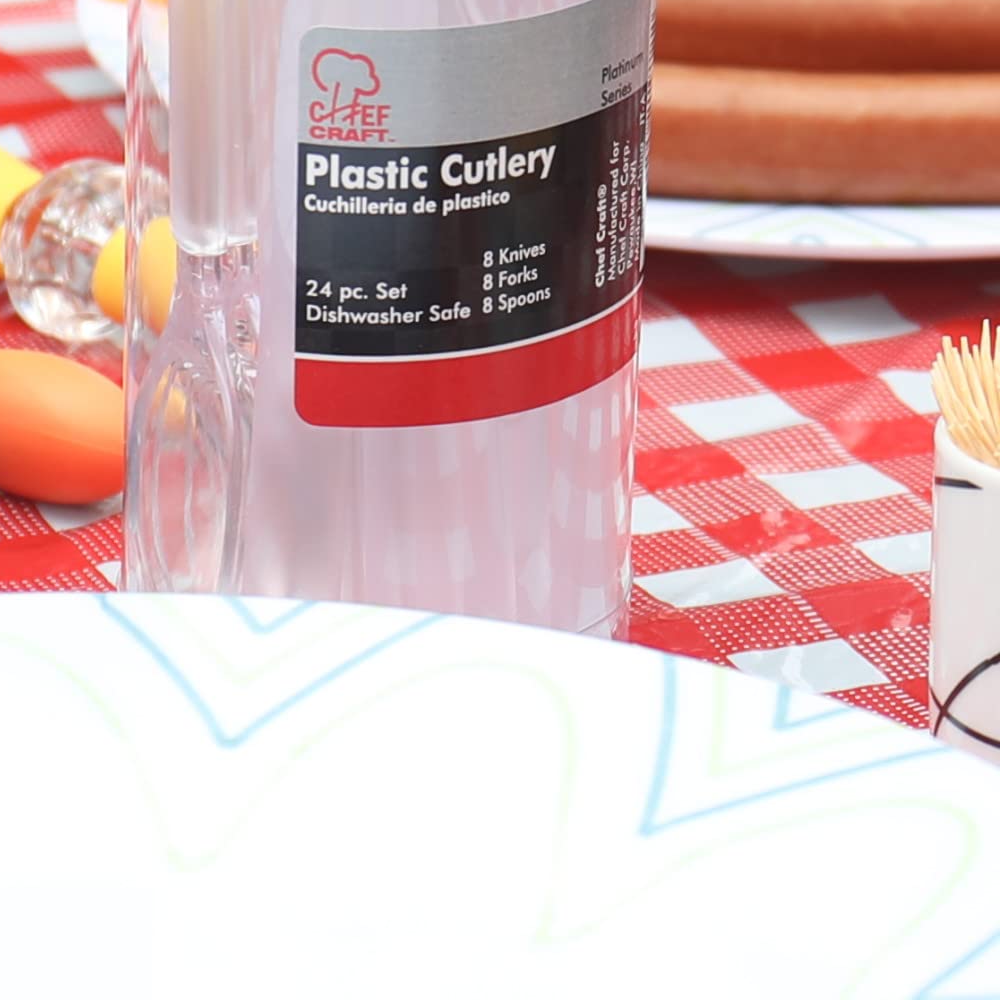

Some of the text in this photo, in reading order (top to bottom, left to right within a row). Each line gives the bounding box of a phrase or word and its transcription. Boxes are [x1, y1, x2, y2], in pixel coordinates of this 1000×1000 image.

[601, 52, 644, 84] Platinum
[601, 82, 632, 107] Series
[309, 99, 391, 126] CHEF
[306, 145, 556, 190] Plastic Cutlery
[304, 189, 510, 217] Cuchilleria de plastico
[608, 141, 620, 281] Manufactured for
[619, 190, 628, 231] Craft
[483, 243, 546, 267] 8 Knives
[595, 247, 605, 287] Chef
[617, 237, 627, 275] Chef
[306, 280, 408, 303] 24 pc. Set
[483, 266, 538, 291] 8 Forks
[306, 302, 471, 324] Dishwasher Safe
[482, 287, 551, 313] 8 Spoons
